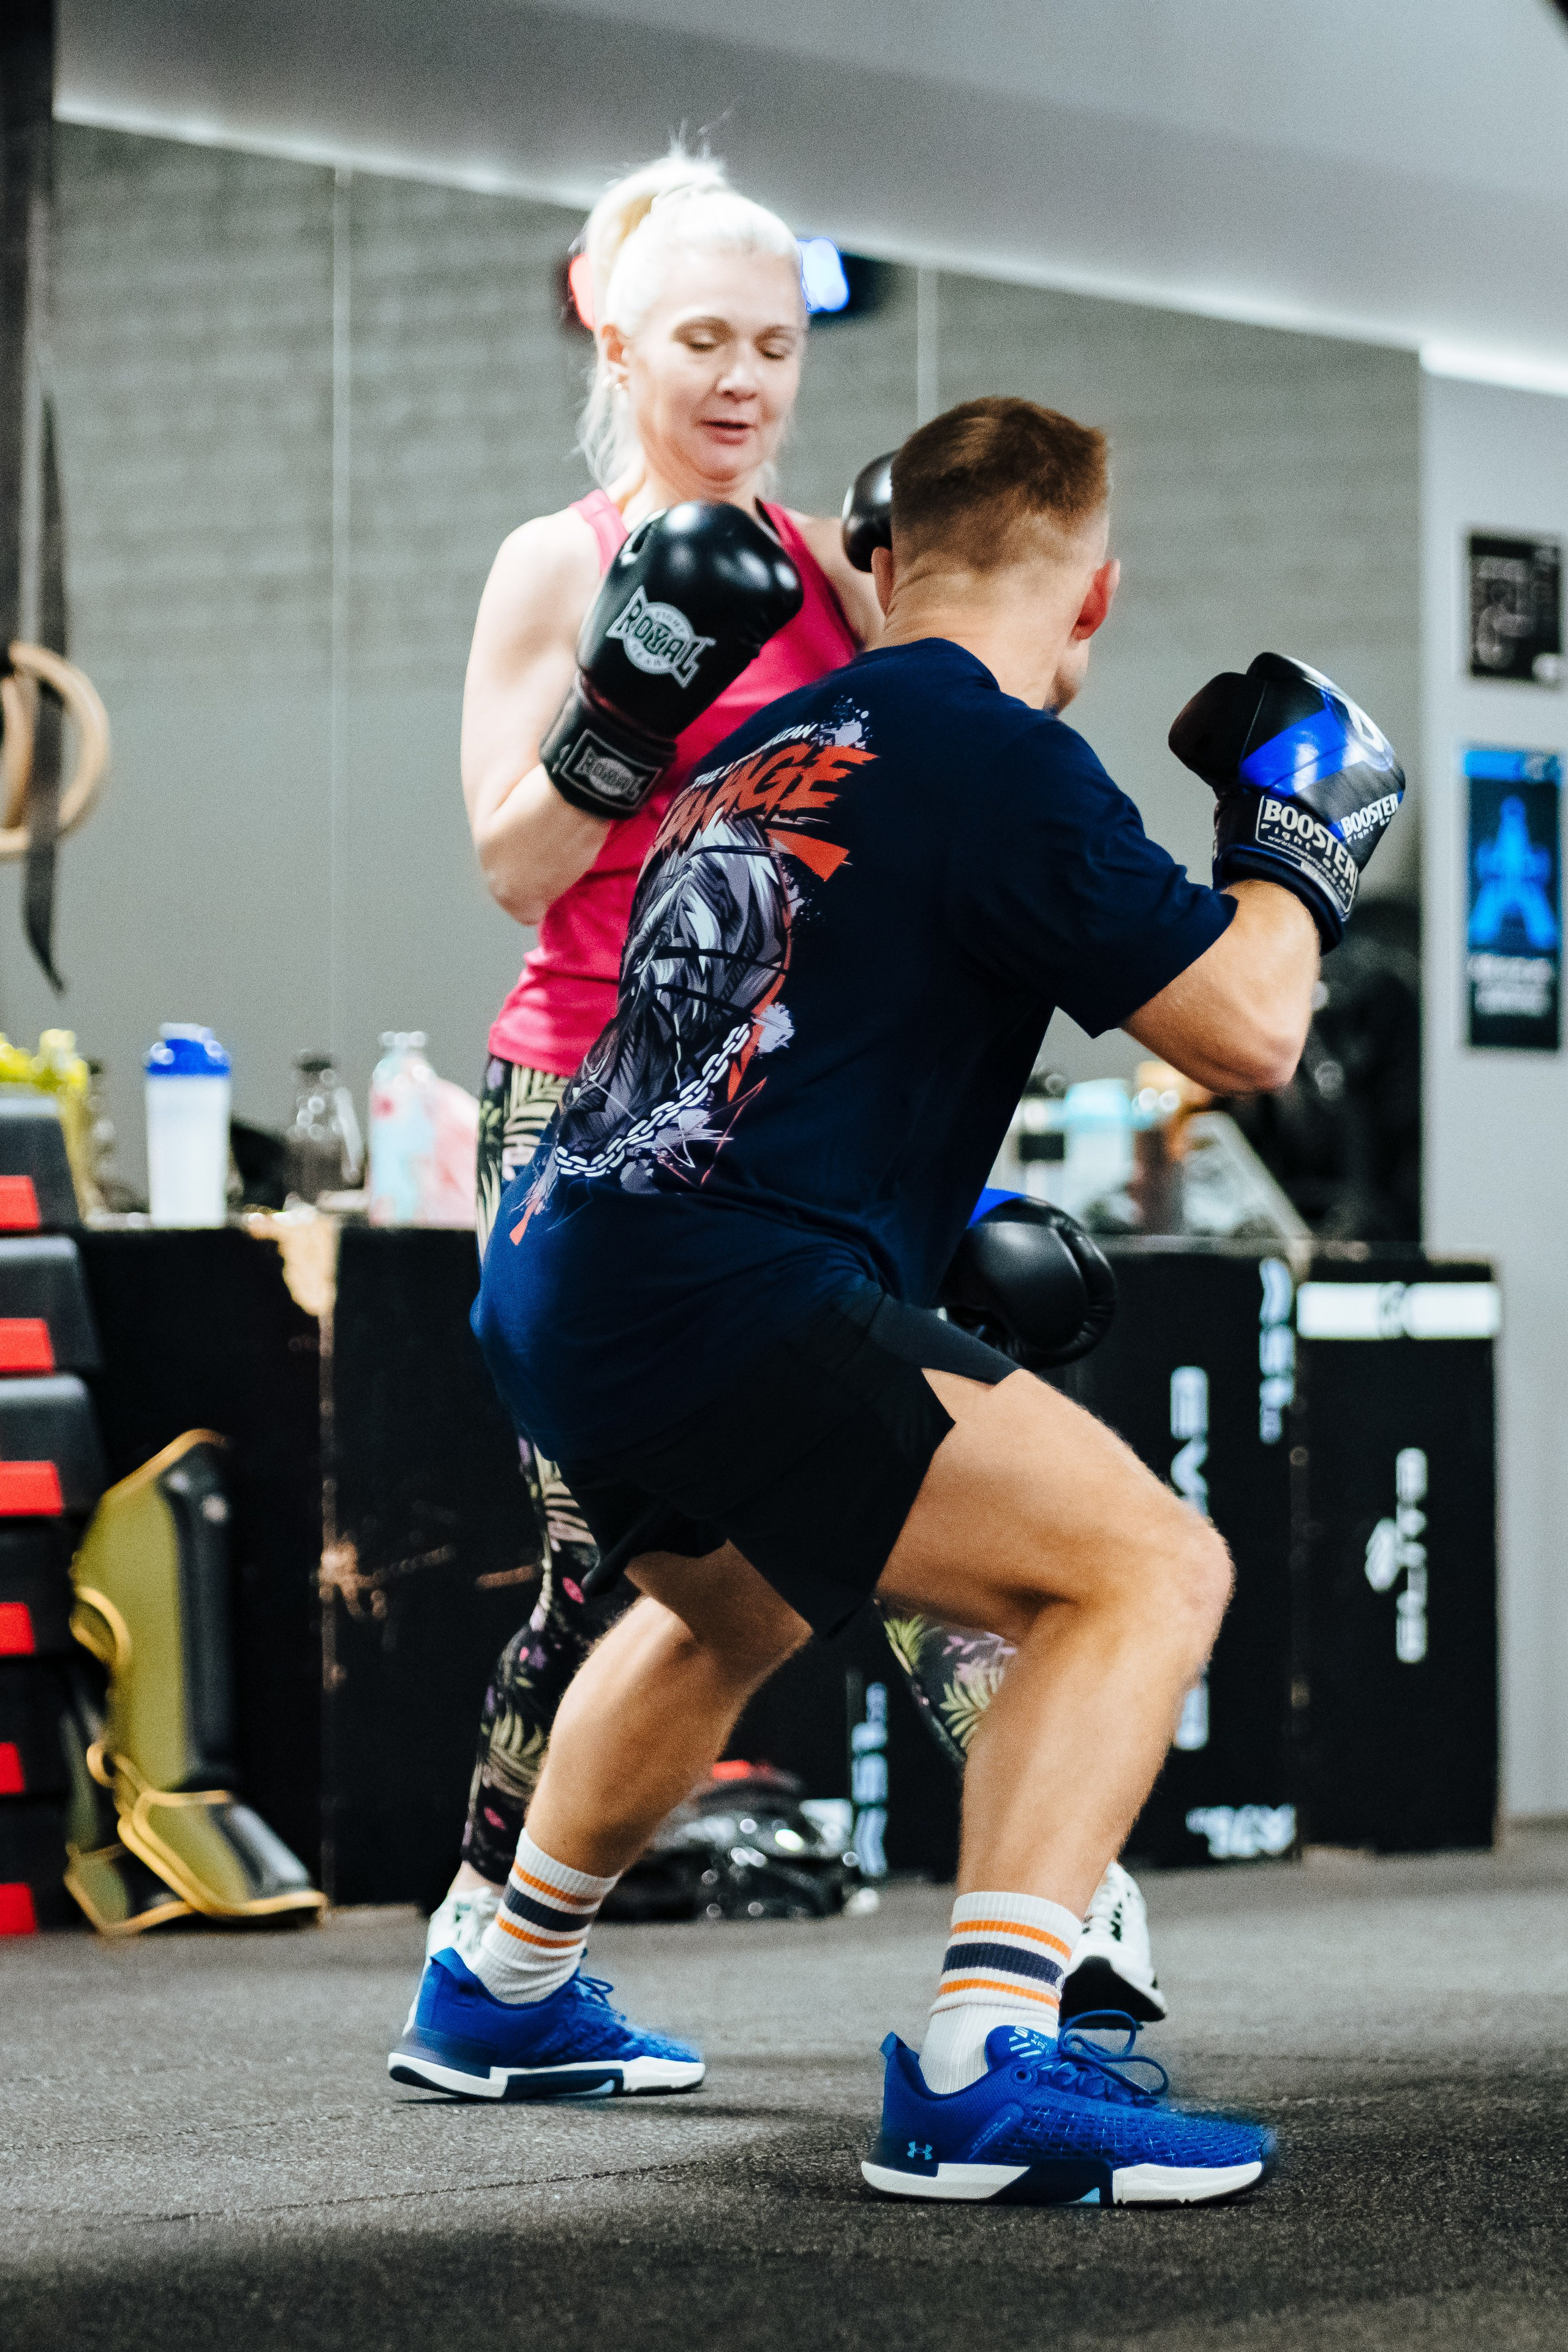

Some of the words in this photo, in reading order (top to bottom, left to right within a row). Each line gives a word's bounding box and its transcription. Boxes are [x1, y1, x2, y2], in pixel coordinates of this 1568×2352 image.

[612, 592, 707, 682] ROYAL
[576, 748, 644, 799] ROYAL
[1262, 799, 1357, 888] BOOSTER
[1341, 793, 1399, 838] BOOSTER
